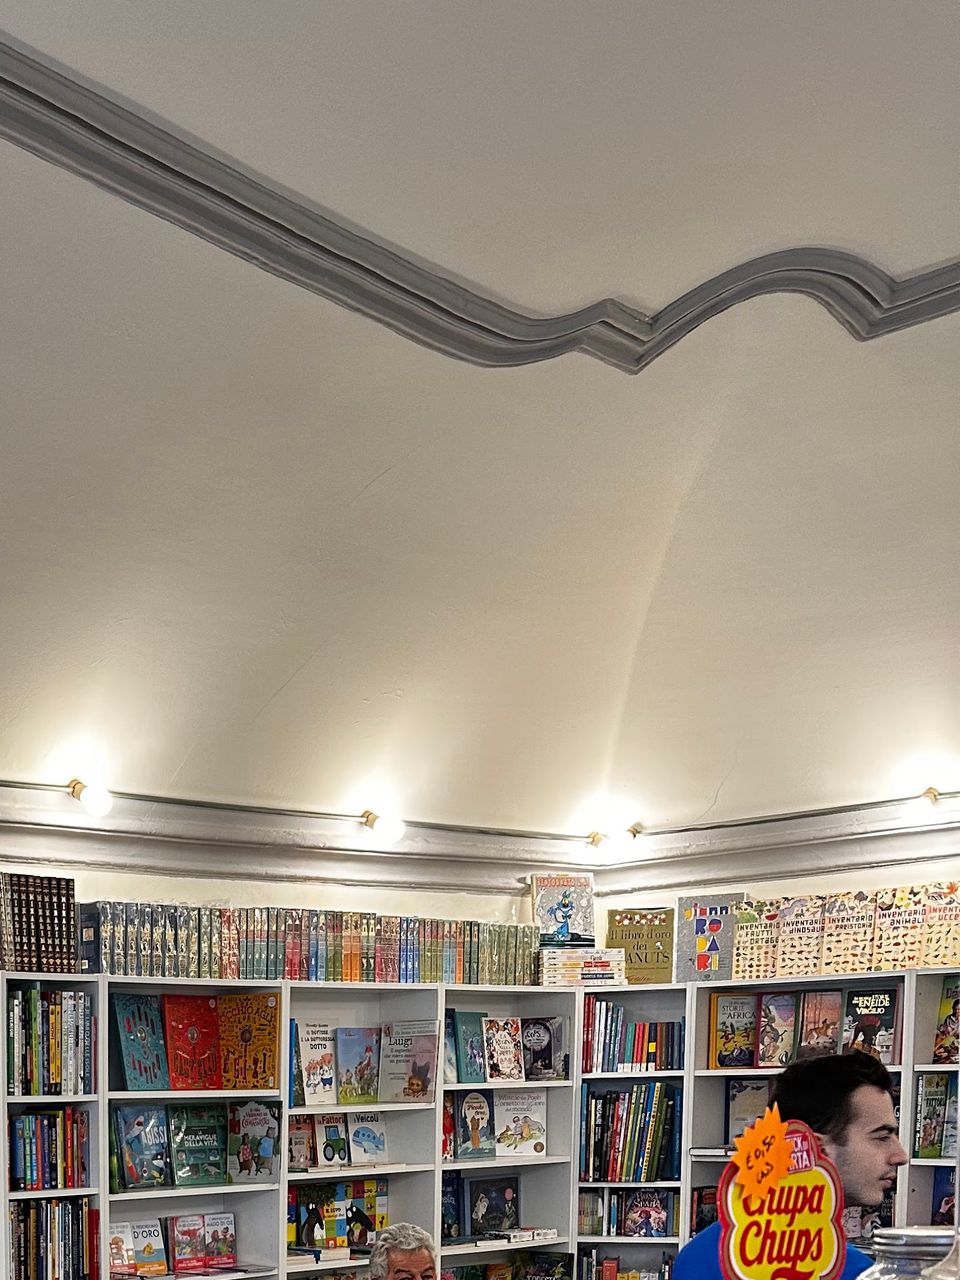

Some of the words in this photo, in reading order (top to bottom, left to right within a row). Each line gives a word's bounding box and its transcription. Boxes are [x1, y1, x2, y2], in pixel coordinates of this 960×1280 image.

[683, 902, 731, 921] giann
[878, 909, 927, 919] INVENTARIO
[783, 918, 825, 927] INVENTARIO
[828, 915, 873, 924] INVENTARIO
[890, 917, 925, 927] ANIMALI
[695, 919, 723, 935] RO
[737, 922, 780, 931] INVENTARIO
[789, 926, 825, 934] DINOSAUR
[835, 922, 873, 931] PREISTORIA
[610, 930, 617, 940] Il
[621, 929, 644, 940] libro
[647, 929, 671, 940] d'oro
[633, 941, 647, 951] dei
[696, 935, 720, 952] DA
[749, 937, 779, 945] ORTAGG
[625, 952, 670, 964] ANUTS
[696, 954, 719, 971] RI
[858, 999, 890, 1008] ENEIDE
[727, 1012, 756, 1020] AFRICA
[856, 1007, 885, 1015] VIRGILIO
[388, 1037, 413, 1047] Luigi
[356, 1113, 379, 1123] Veicoli
[141, 1127, 168, 1144] ABISSI
[184, 1133, 218, 1141] MERAVIGLIE
[133, 1229, 160, 1239] D'ORO
